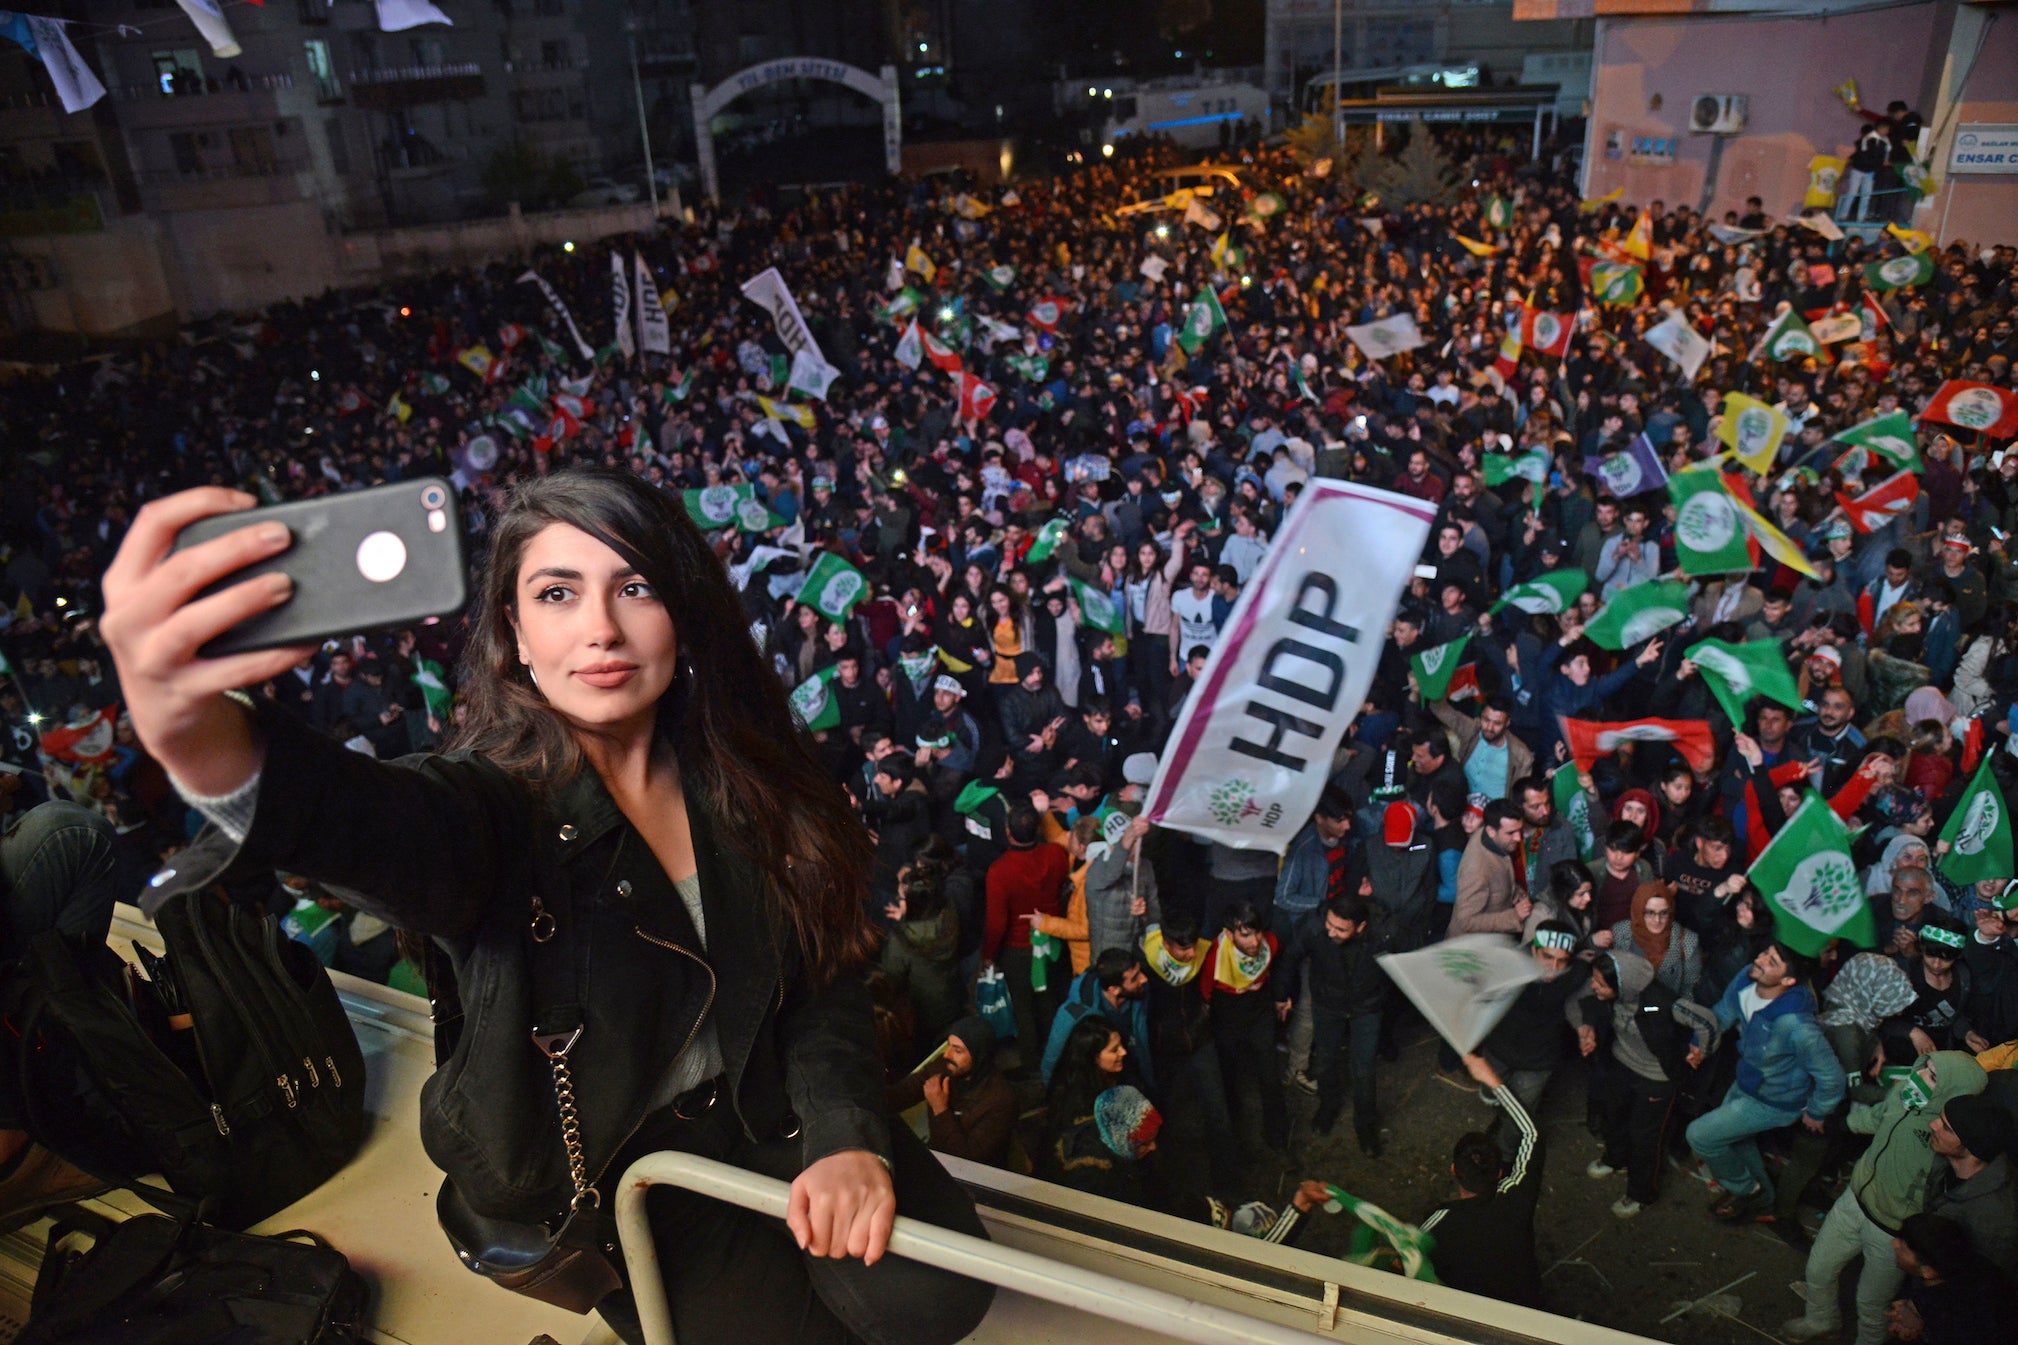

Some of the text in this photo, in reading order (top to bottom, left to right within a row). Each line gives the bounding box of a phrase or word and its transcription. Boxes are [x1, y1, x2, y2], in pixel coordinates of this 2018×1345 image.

[1956, 154, 2005, 163] ENSAR
[1228, 571, 1362, 773] HDP
[1260, 803, 1283, 829] HDP
